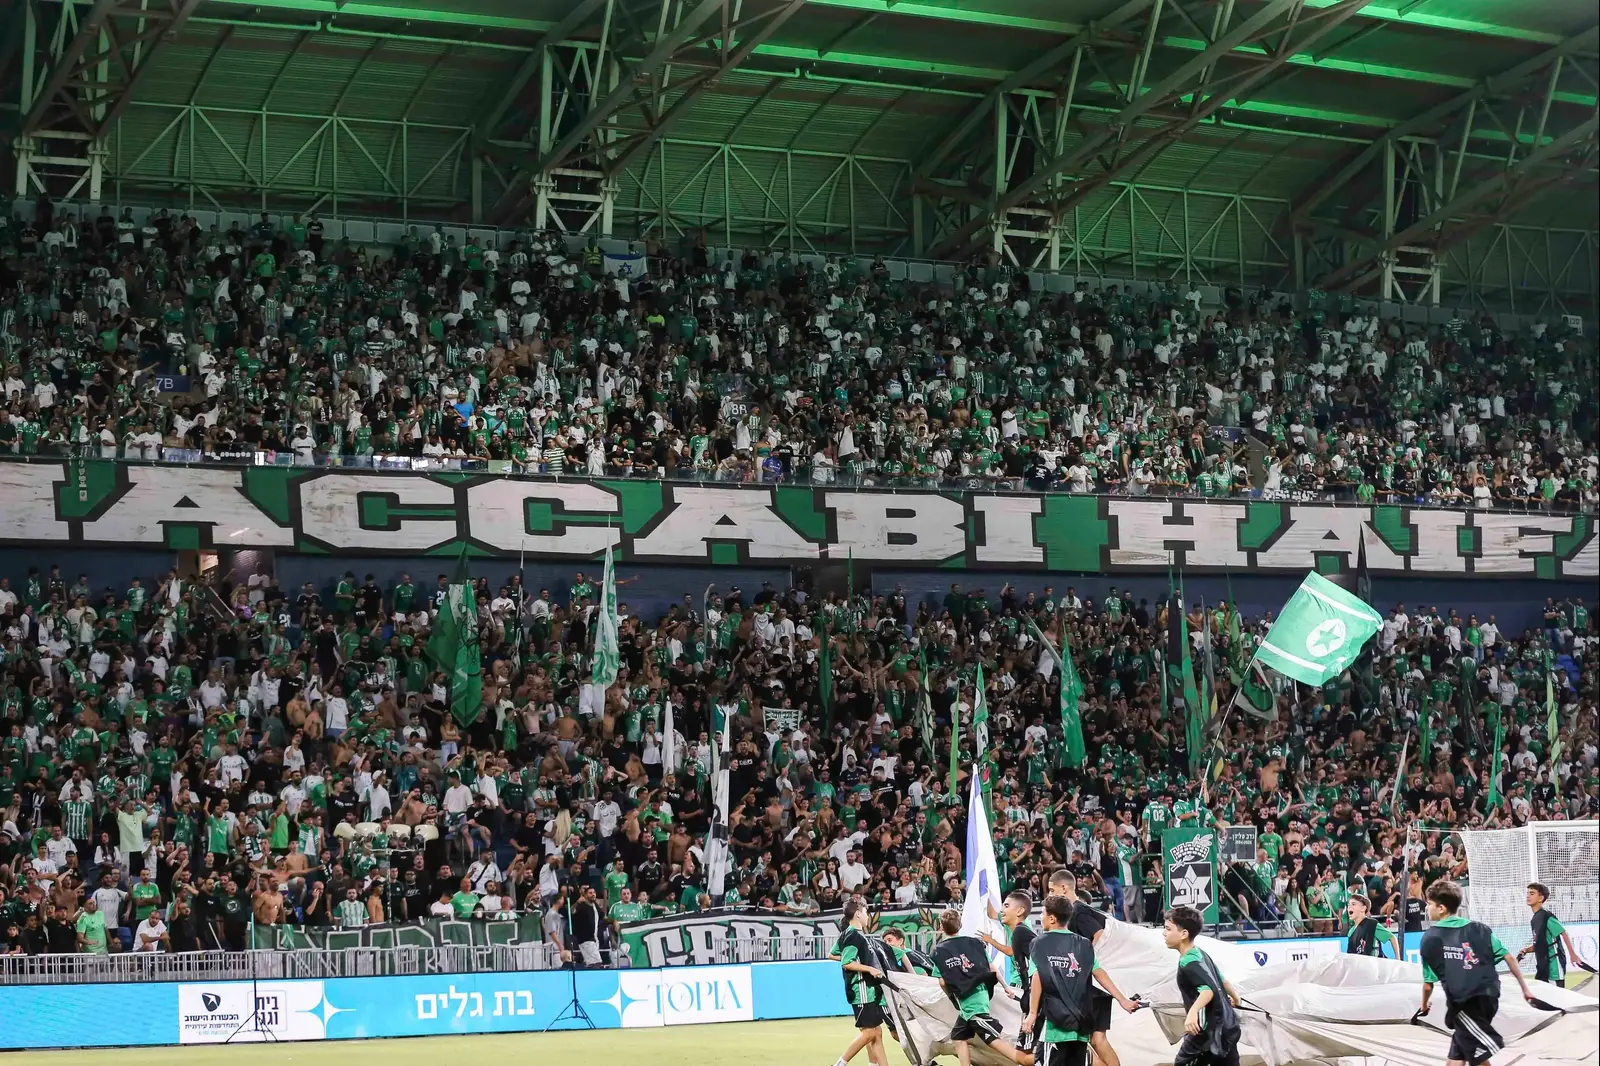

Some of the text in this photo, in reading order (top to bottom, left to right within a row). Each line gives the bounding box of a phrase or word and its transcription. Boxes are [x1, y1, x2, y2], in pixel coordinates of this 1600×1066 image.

[1108, 499, 1600, 577] HAIF
[256, 996, 279, 1010] בית
[415, 985, 535, 1019] בת גלים
[647, 979, 742, 1015] TOPIA
[184, 1013, 239, 1022] הכשרת הישוב
